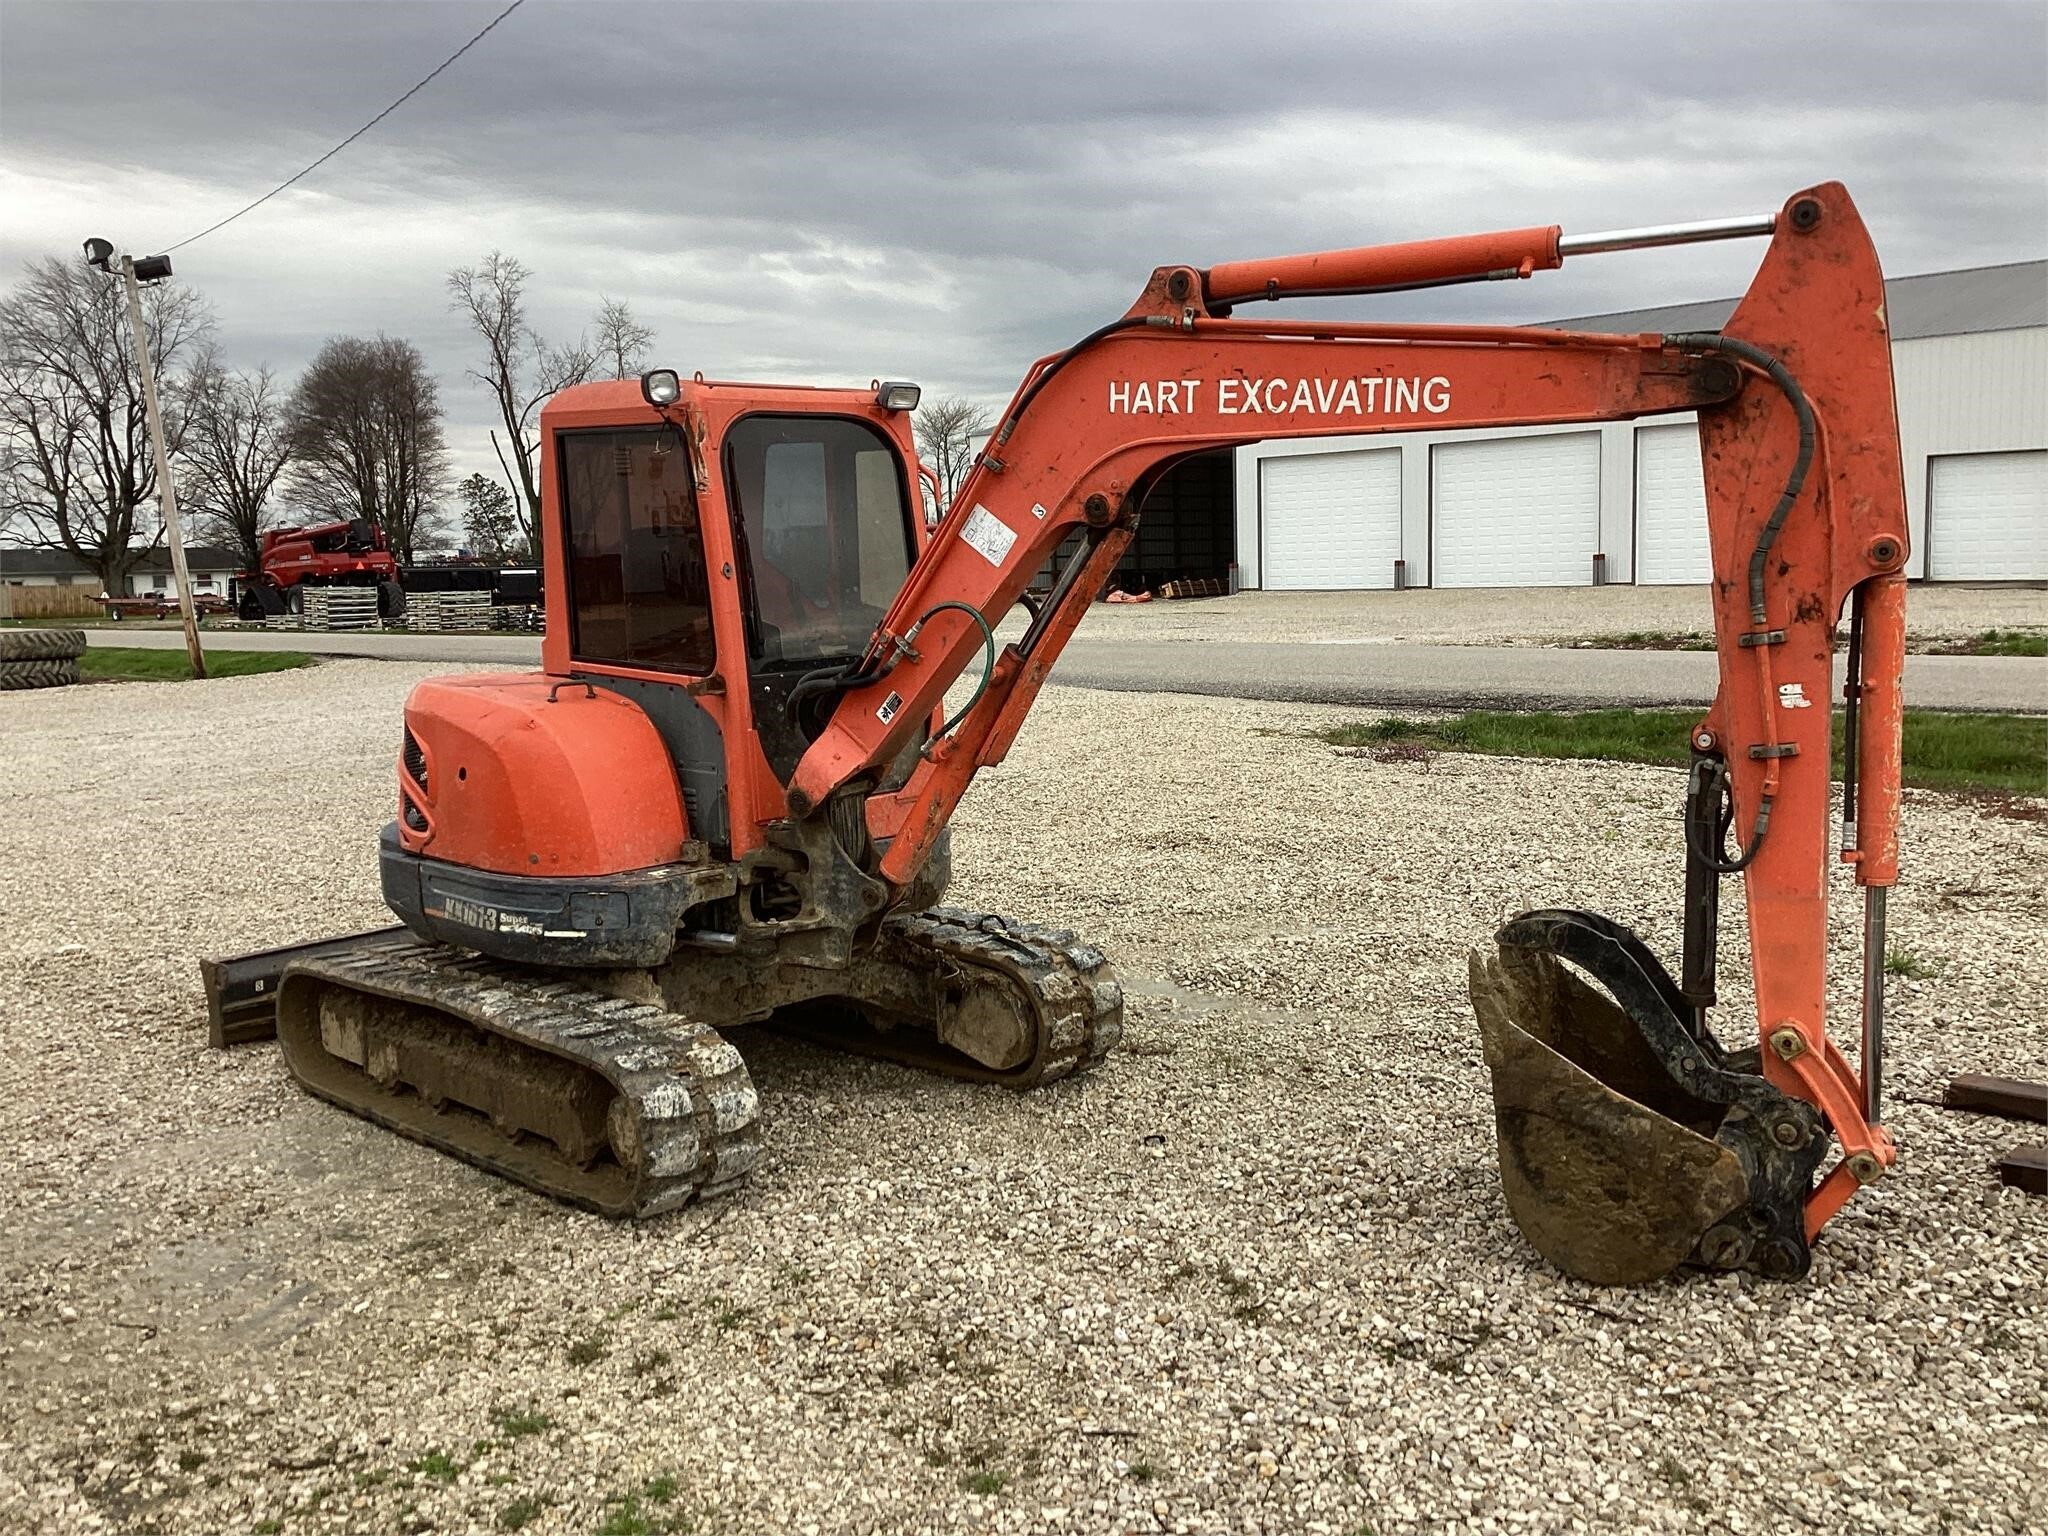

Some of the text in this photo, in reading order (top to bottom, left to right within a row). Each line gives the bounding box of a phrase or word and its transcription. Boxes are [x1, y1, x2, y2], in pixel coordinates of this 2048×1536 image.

[1109, 377, 1451, 415] HART EXCAVATING
[500, 912, 529, 925] Super
